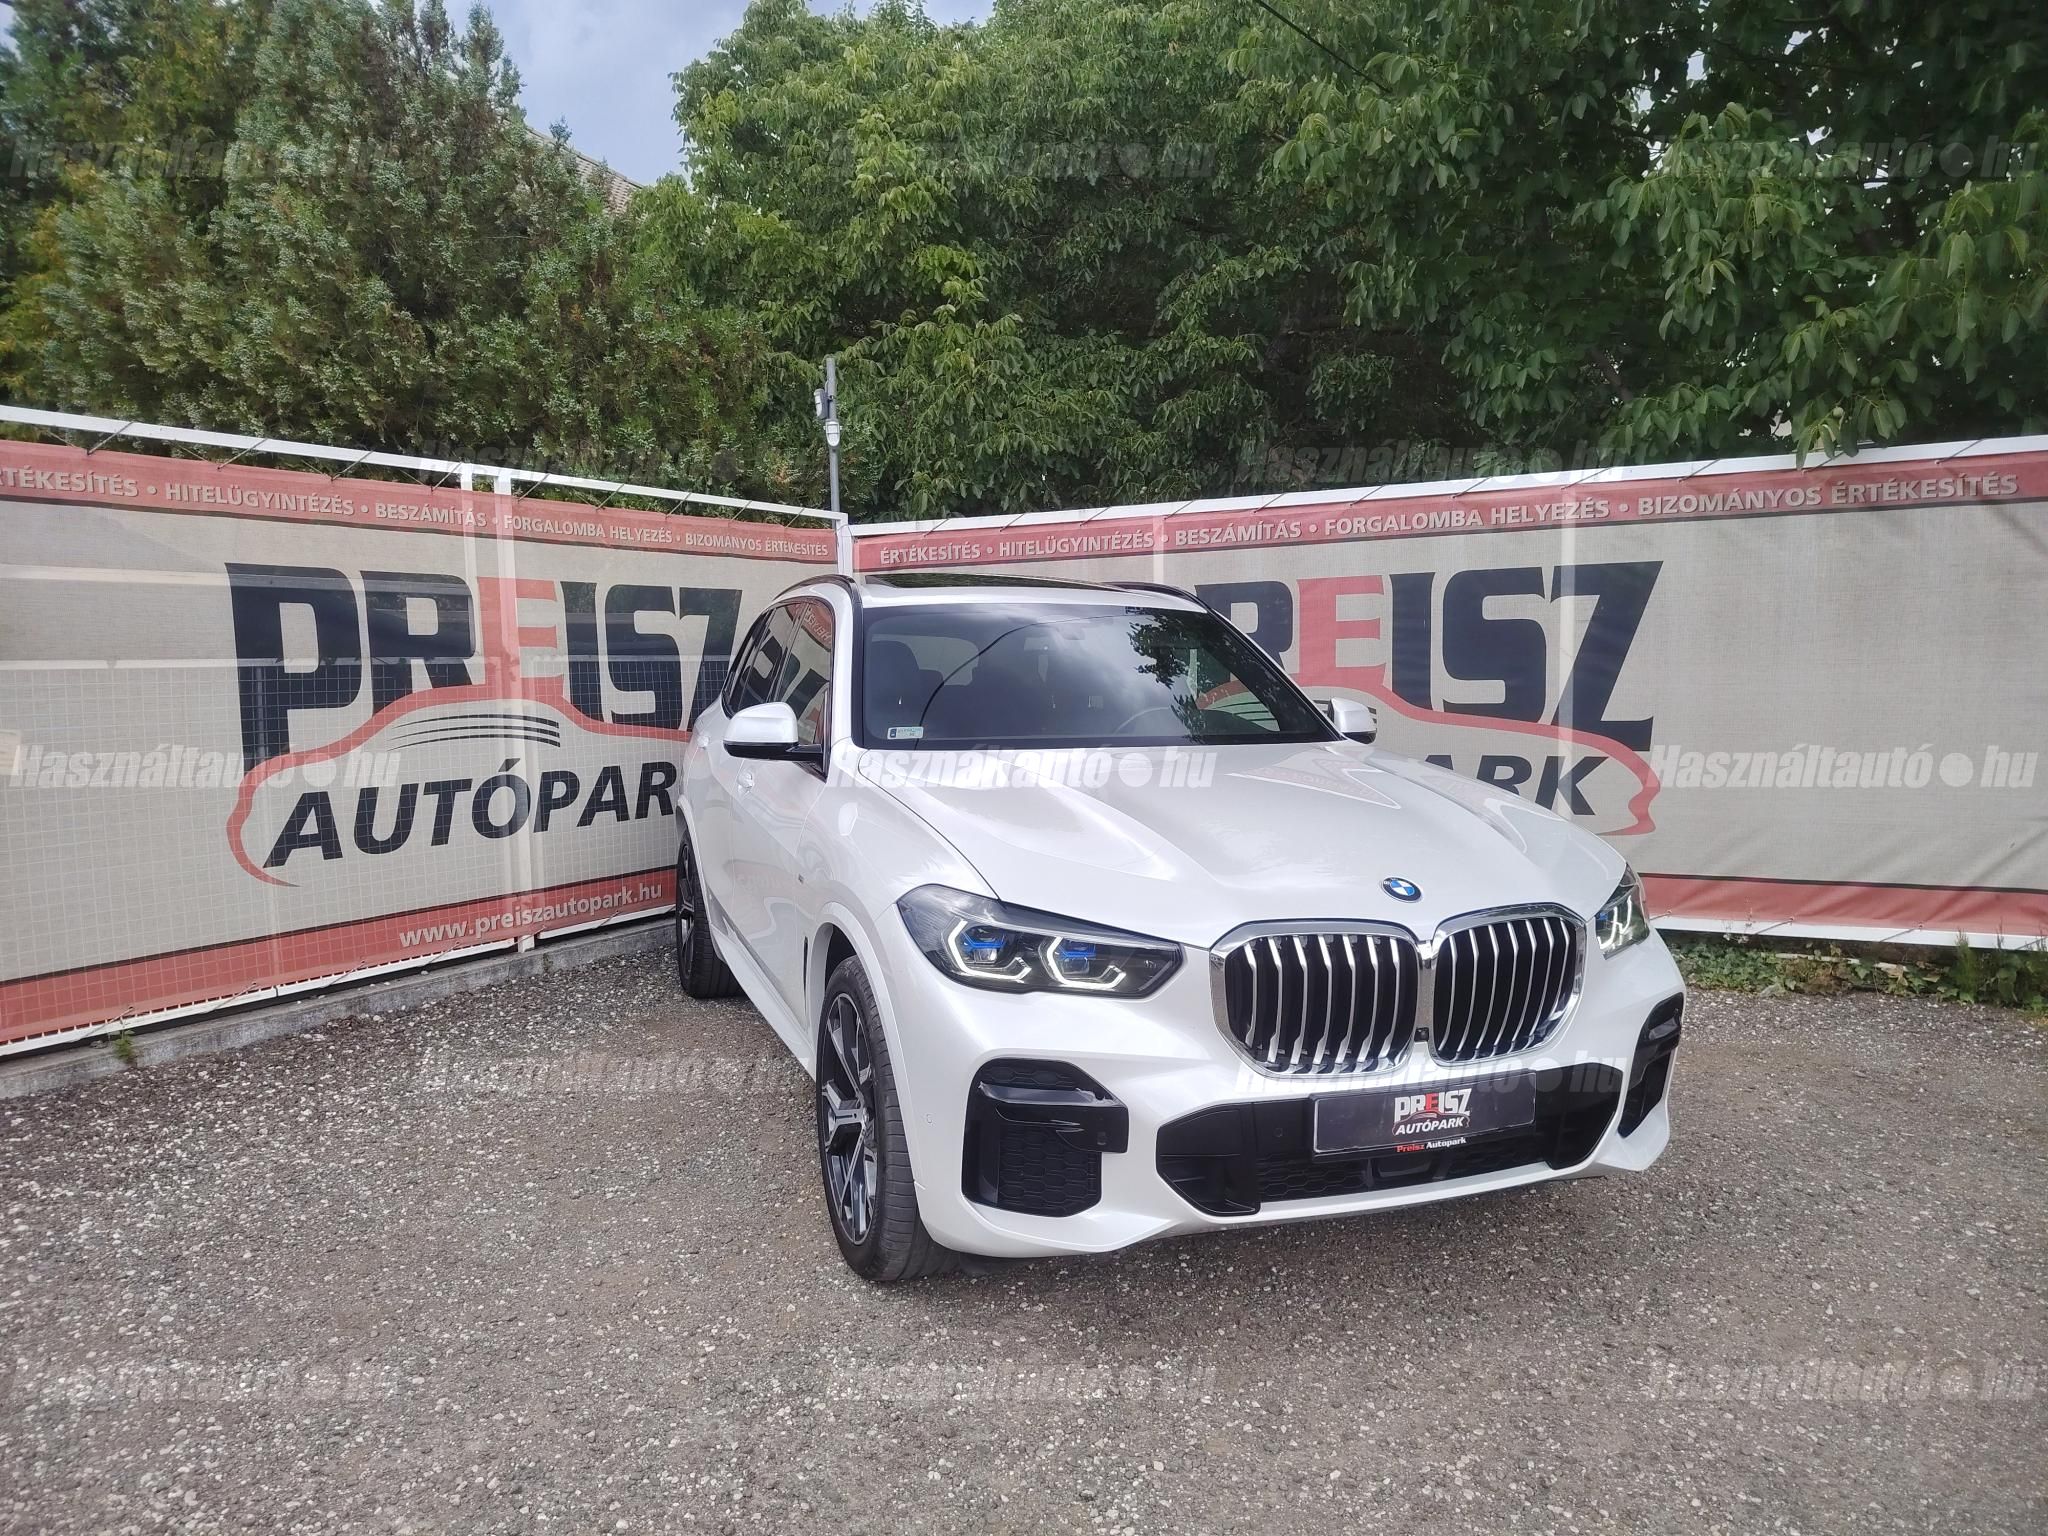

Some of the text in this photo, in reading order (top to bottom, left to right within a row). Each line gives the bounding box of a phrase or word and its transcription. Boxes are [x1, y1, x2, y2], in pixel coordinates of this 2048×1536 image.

[0, 465, 139, 498] TÉKESÍTÉS
[165, 482, 355, 516] HITELÜGYINTÉZÉS
[375, 502, 487, 528] BESZÁMÍTÁS
[503, 514, 606, 538] FORGALOMBA
[609, 525, 673, 544] HELYEZÉS
[685, 532, 762, 551] BIZOMÁNYOS
[880, 472, 2018, 565] ÉRTÉKESÍTÉS HITELÜGYINTÉZÉS BESZÁMÍTÁS FORGALOMBA HELYEZÉS BIZOMÁNYOS ÉRTÉKESÍTÉS
[223, 562, 742, 774] PREISZ
[1194, 560, 1663, 752] REISZ
[262, 757, 678, 868] AUTÓPAR
[400, 883, 663, 948] www.preiszautopark.hu
[1394, 1088, 1472, 1122] PREISZ
[1395, 1117, 1464, 1136] AUTÓPARK
[1396, 1137, 1467, 1153] Preisz Autopark
